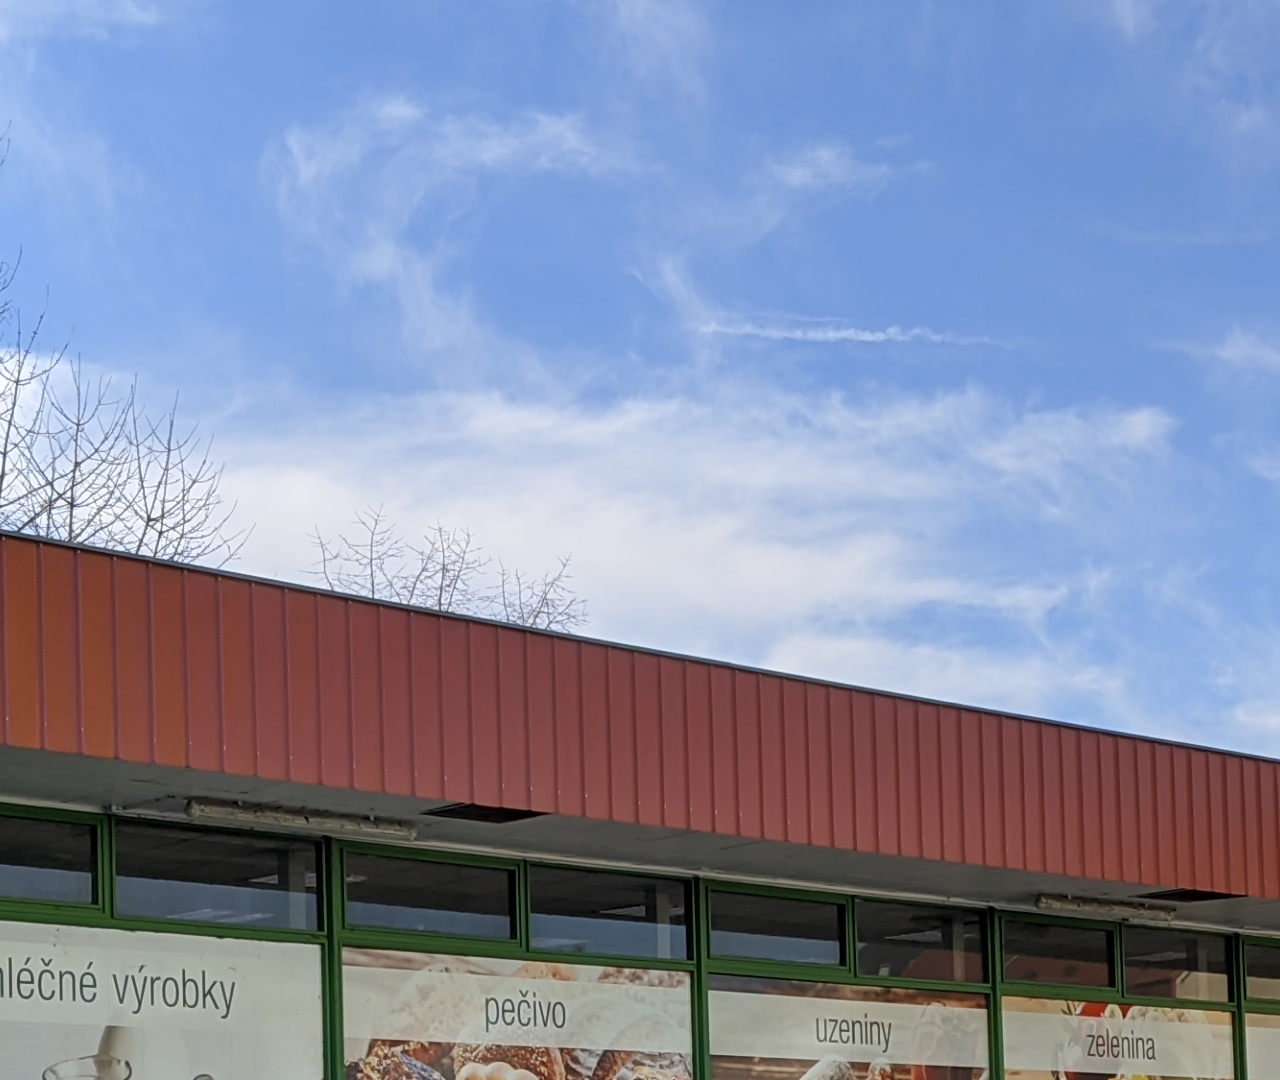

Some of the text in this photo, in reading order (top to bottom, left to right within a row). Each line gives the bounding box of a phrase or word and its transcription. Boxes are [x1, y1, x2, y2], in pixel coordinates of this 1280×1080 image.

[111, 964, 236, 1020] výrobky
[485, 989, 566, 1033] pečivo
[815, 1012, 892, 1053] uzeniny
[1086, 1028, 1157, 1061] zelenina
